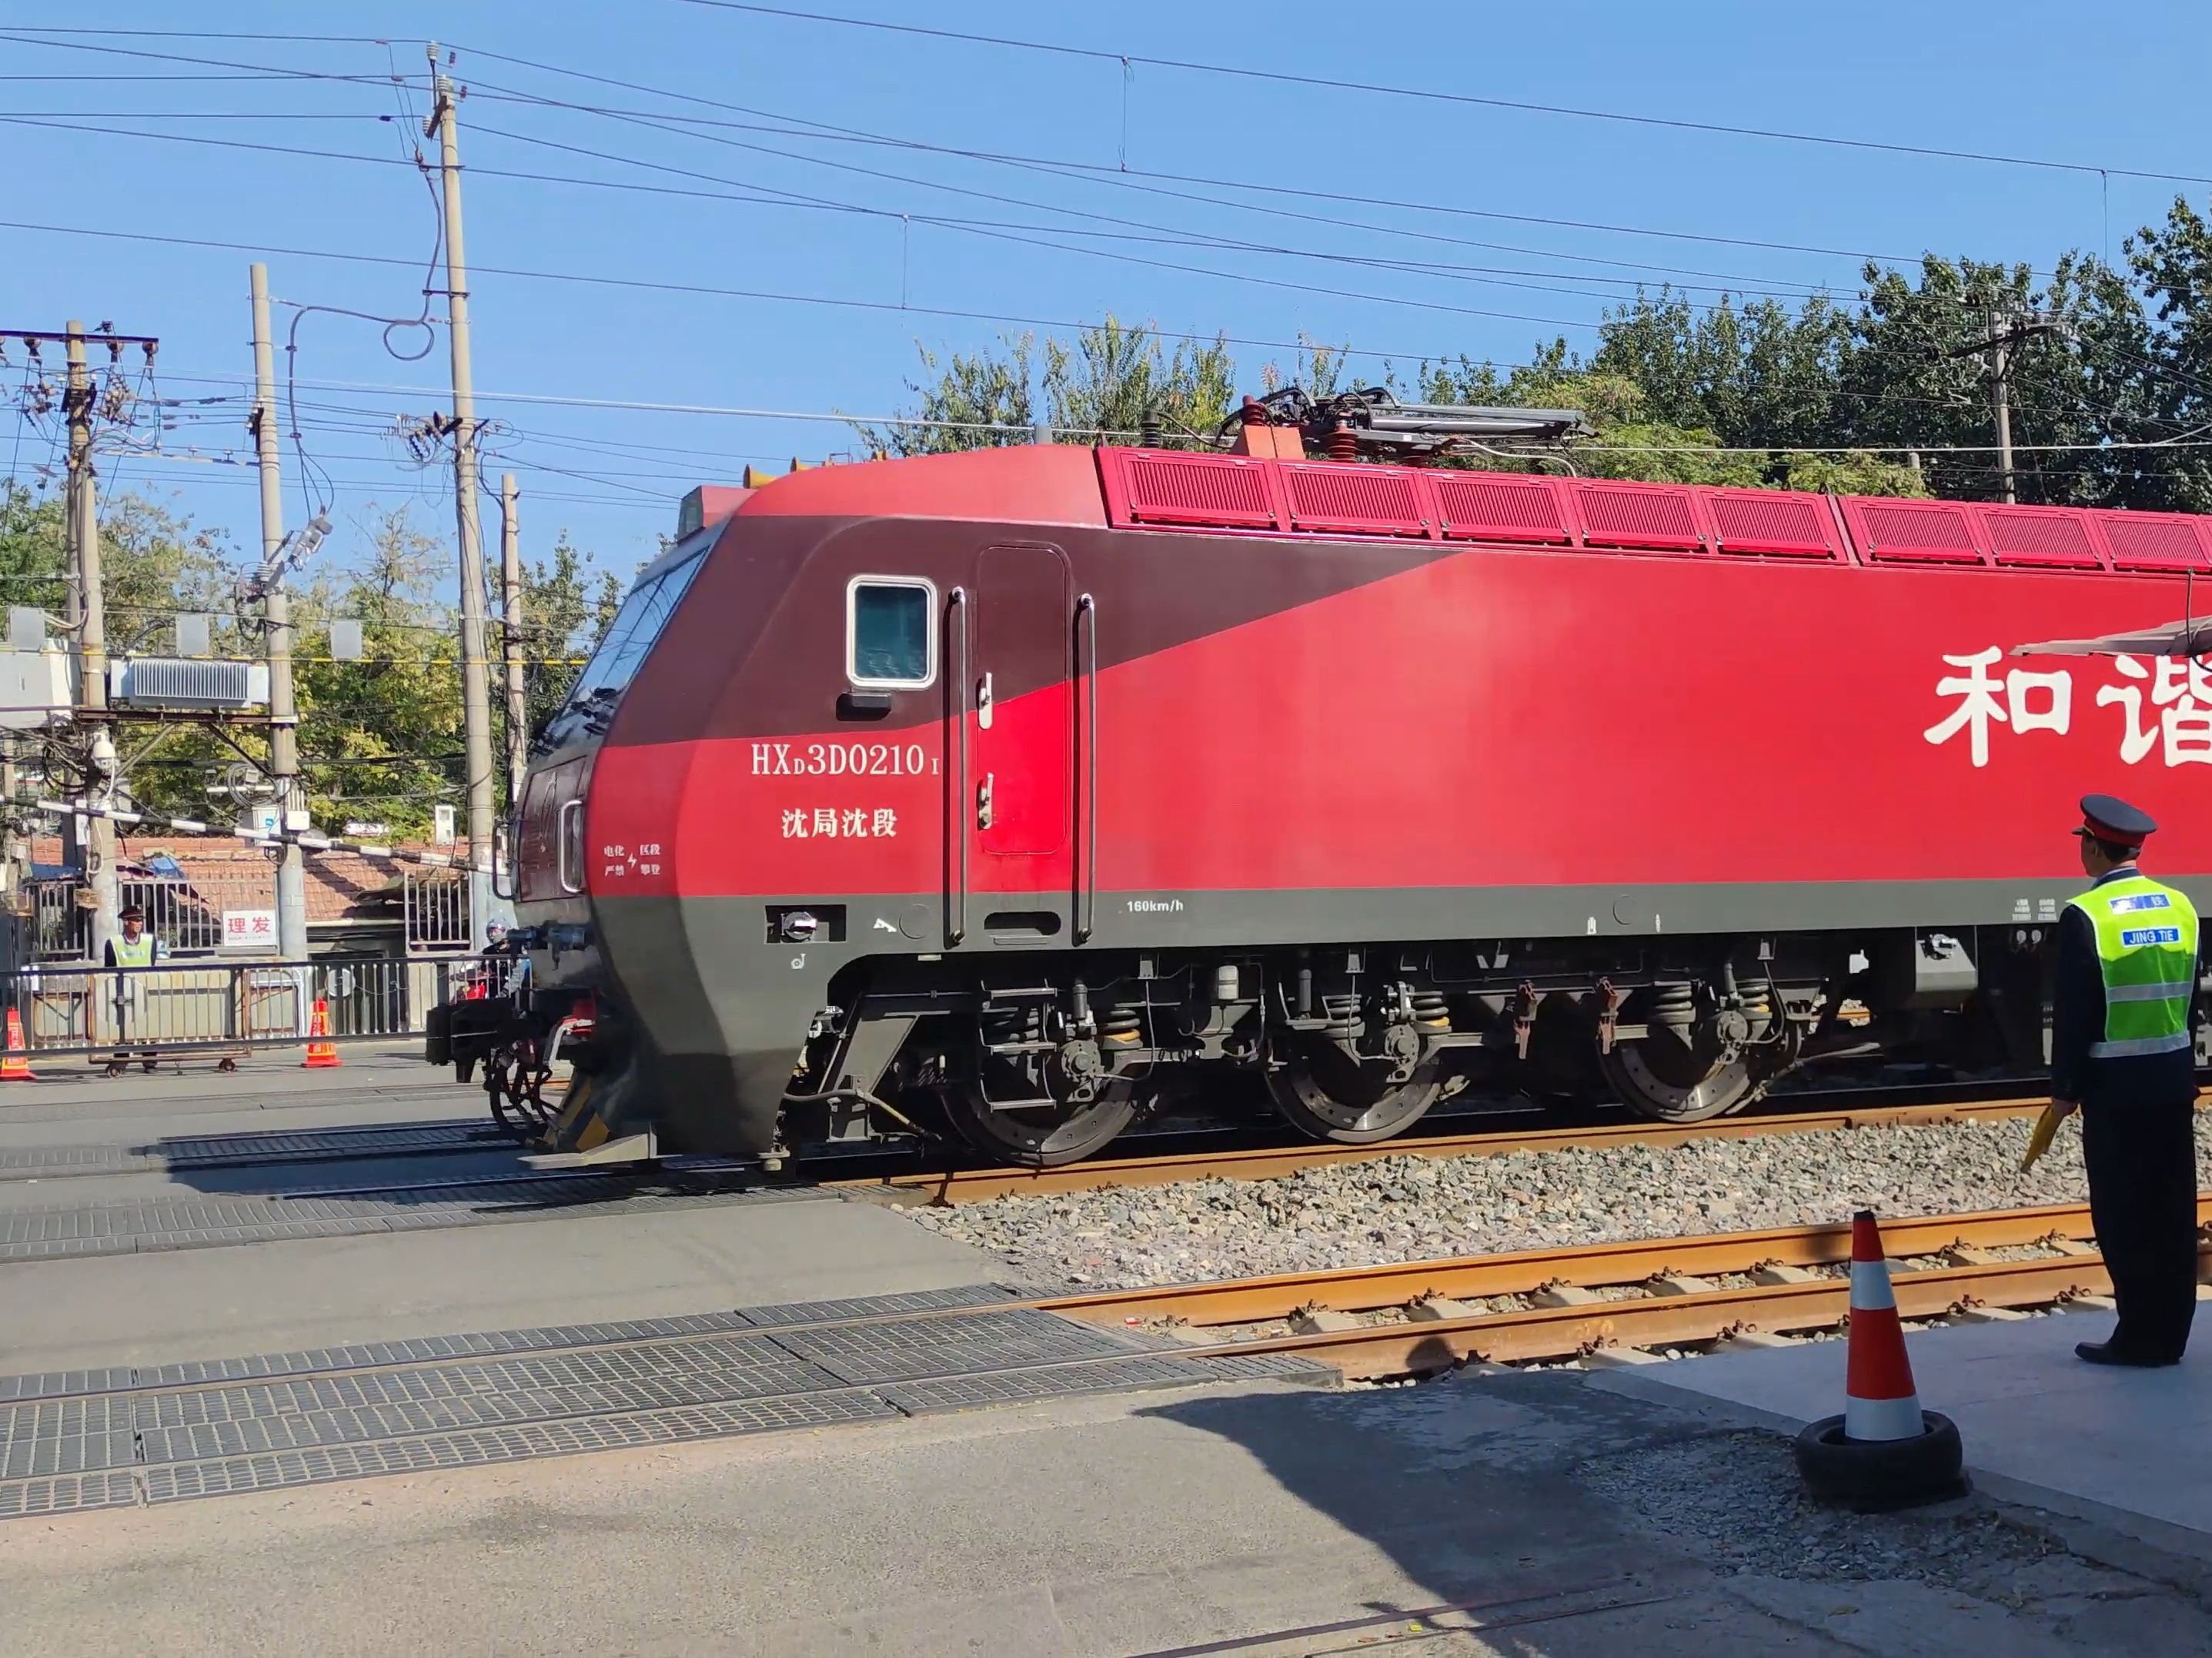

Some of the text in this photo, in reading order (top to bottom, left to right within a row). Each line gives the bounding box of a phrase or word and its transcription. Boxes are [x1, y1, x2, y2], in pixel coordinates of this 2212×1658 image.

[1923, 645, 2212, 767] 和谐
[781, 807, 897, 838] 沈局沈段
[1127, 899, 1184, 912] 160km/h
[228, 916, 271, 933] 理发
[2130, 930, 2174, 944] JING TIE
